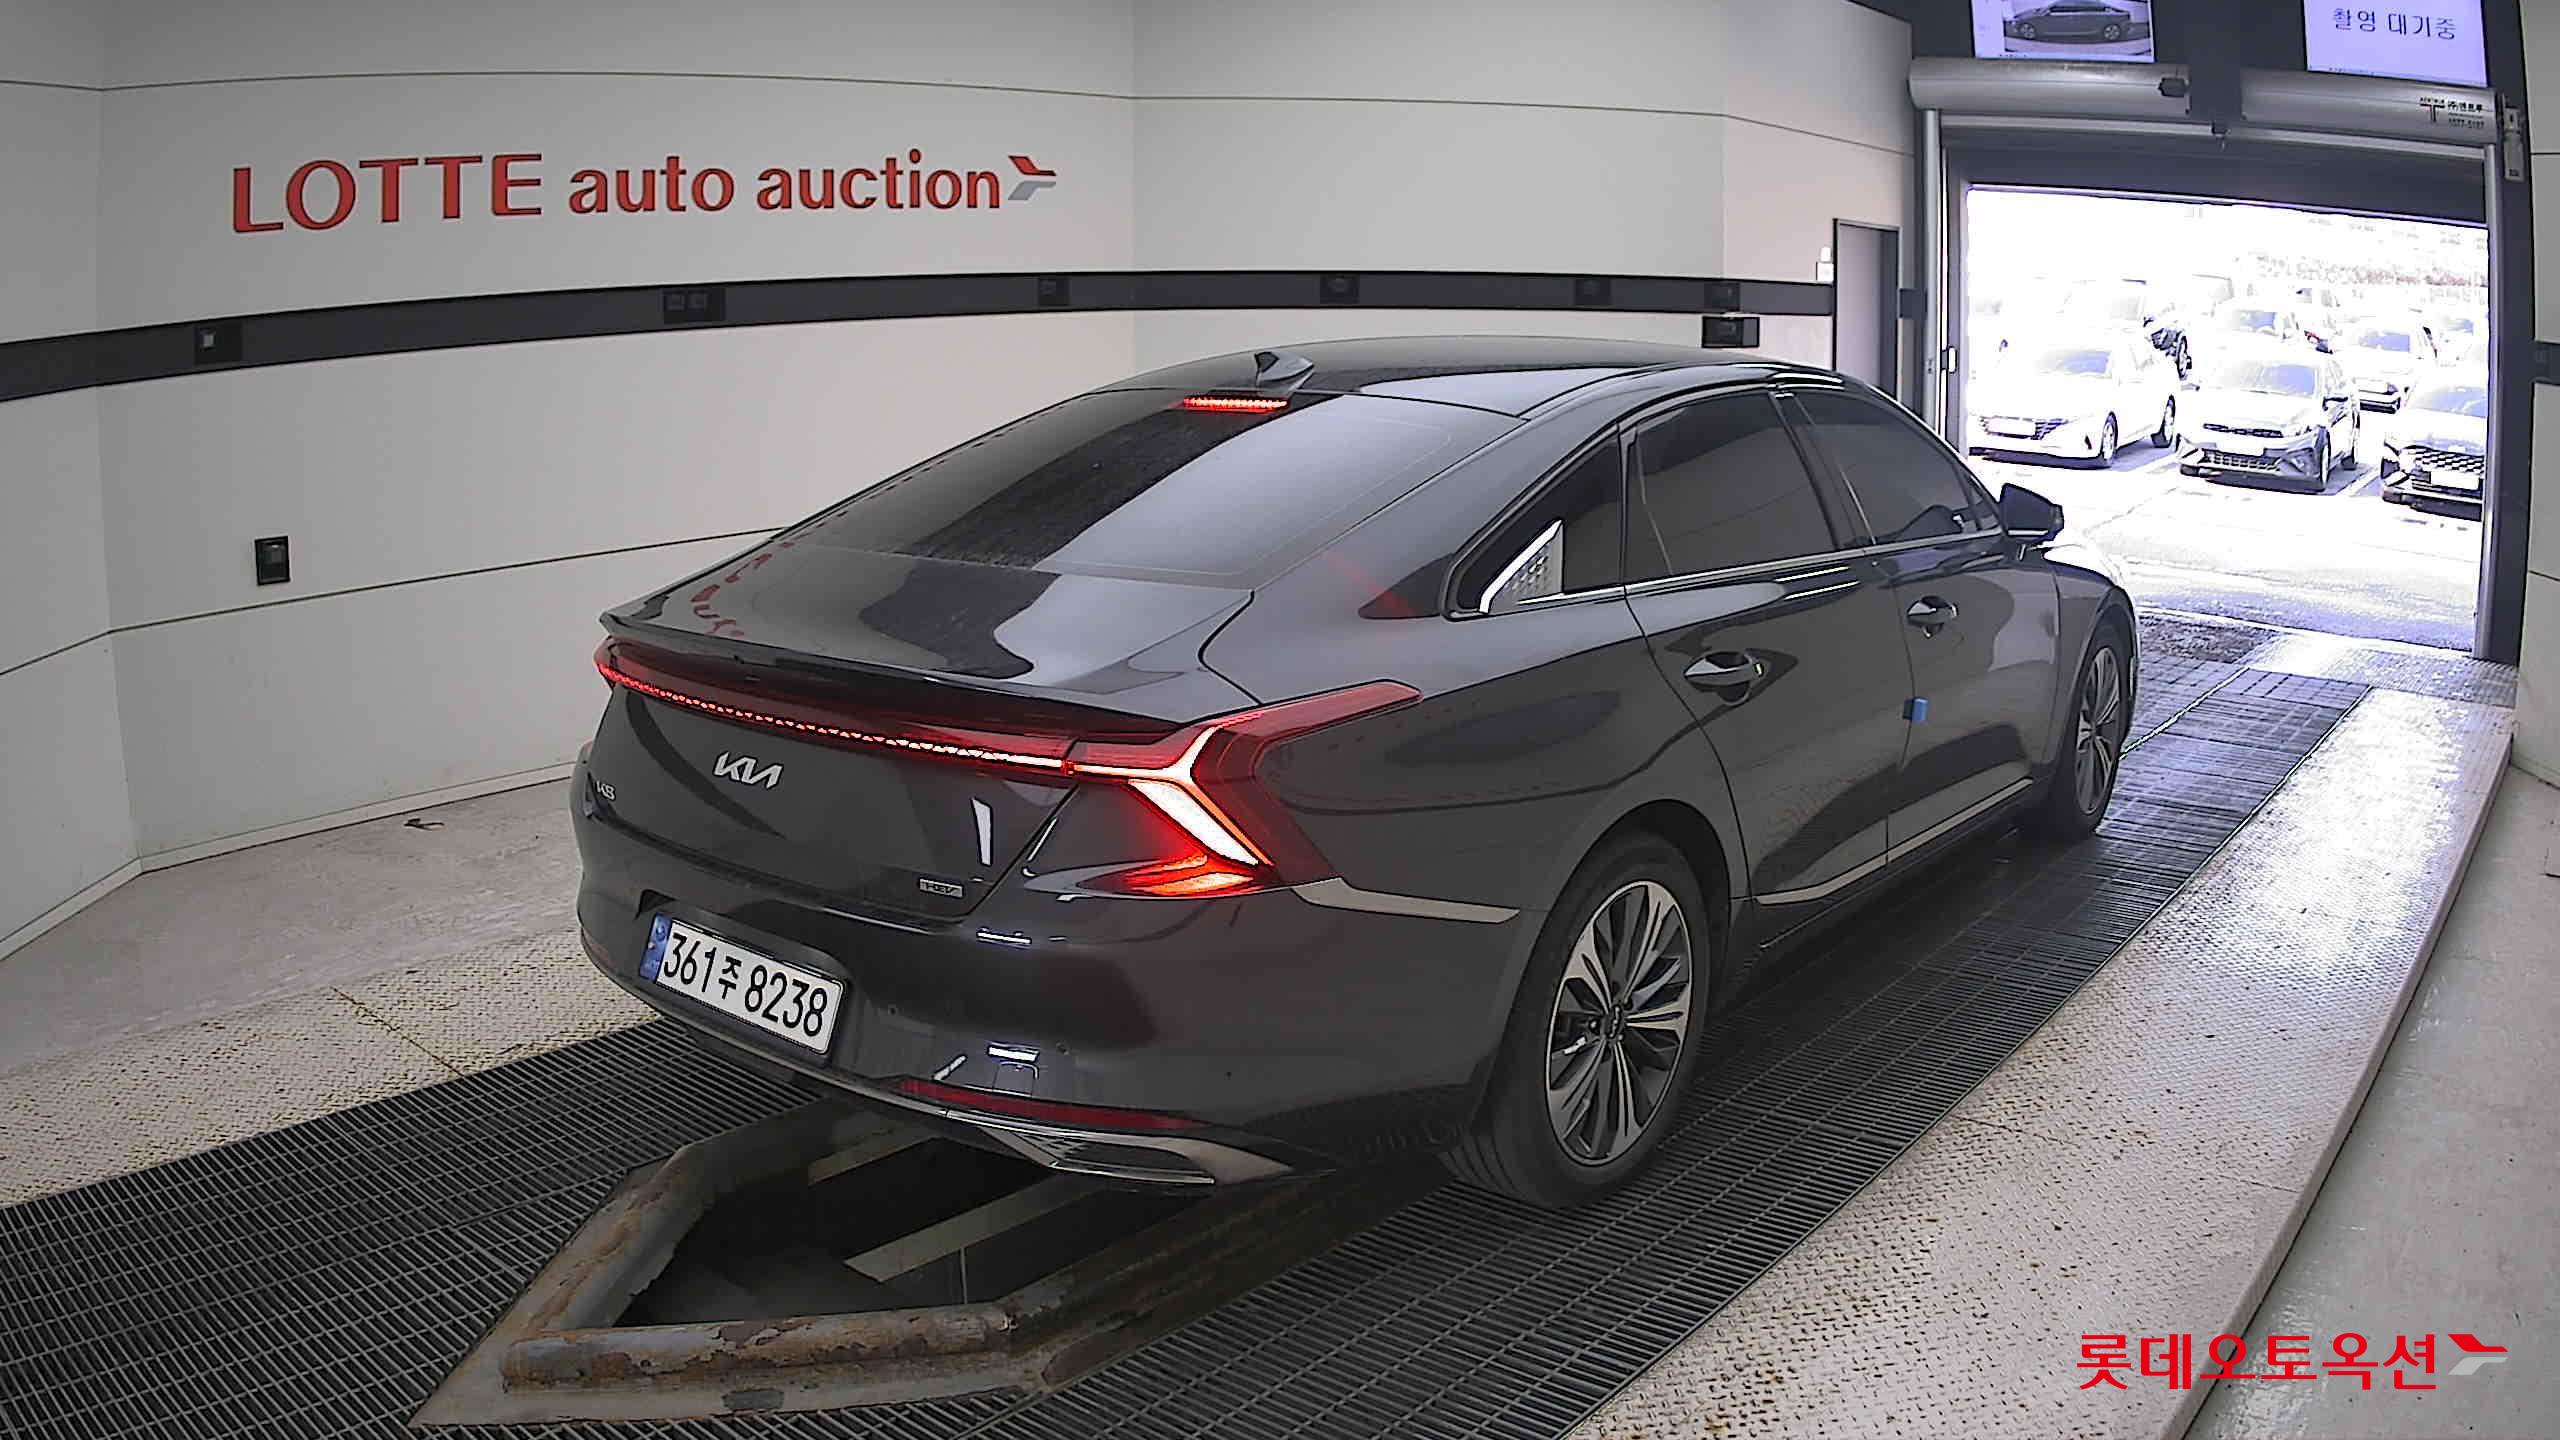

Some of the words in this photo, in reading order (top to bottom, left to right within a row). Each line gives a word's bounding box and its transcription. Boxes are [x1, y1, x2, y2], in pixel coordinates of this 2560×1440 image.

[2333, 8, 2376, 32] 촬영
[2387, 13, 2457, 40] 대기중
[233, 153, 542, 233] LOTTE
[568, 156, 734, 213] auto
[757, 149, 1001, 210] auction
